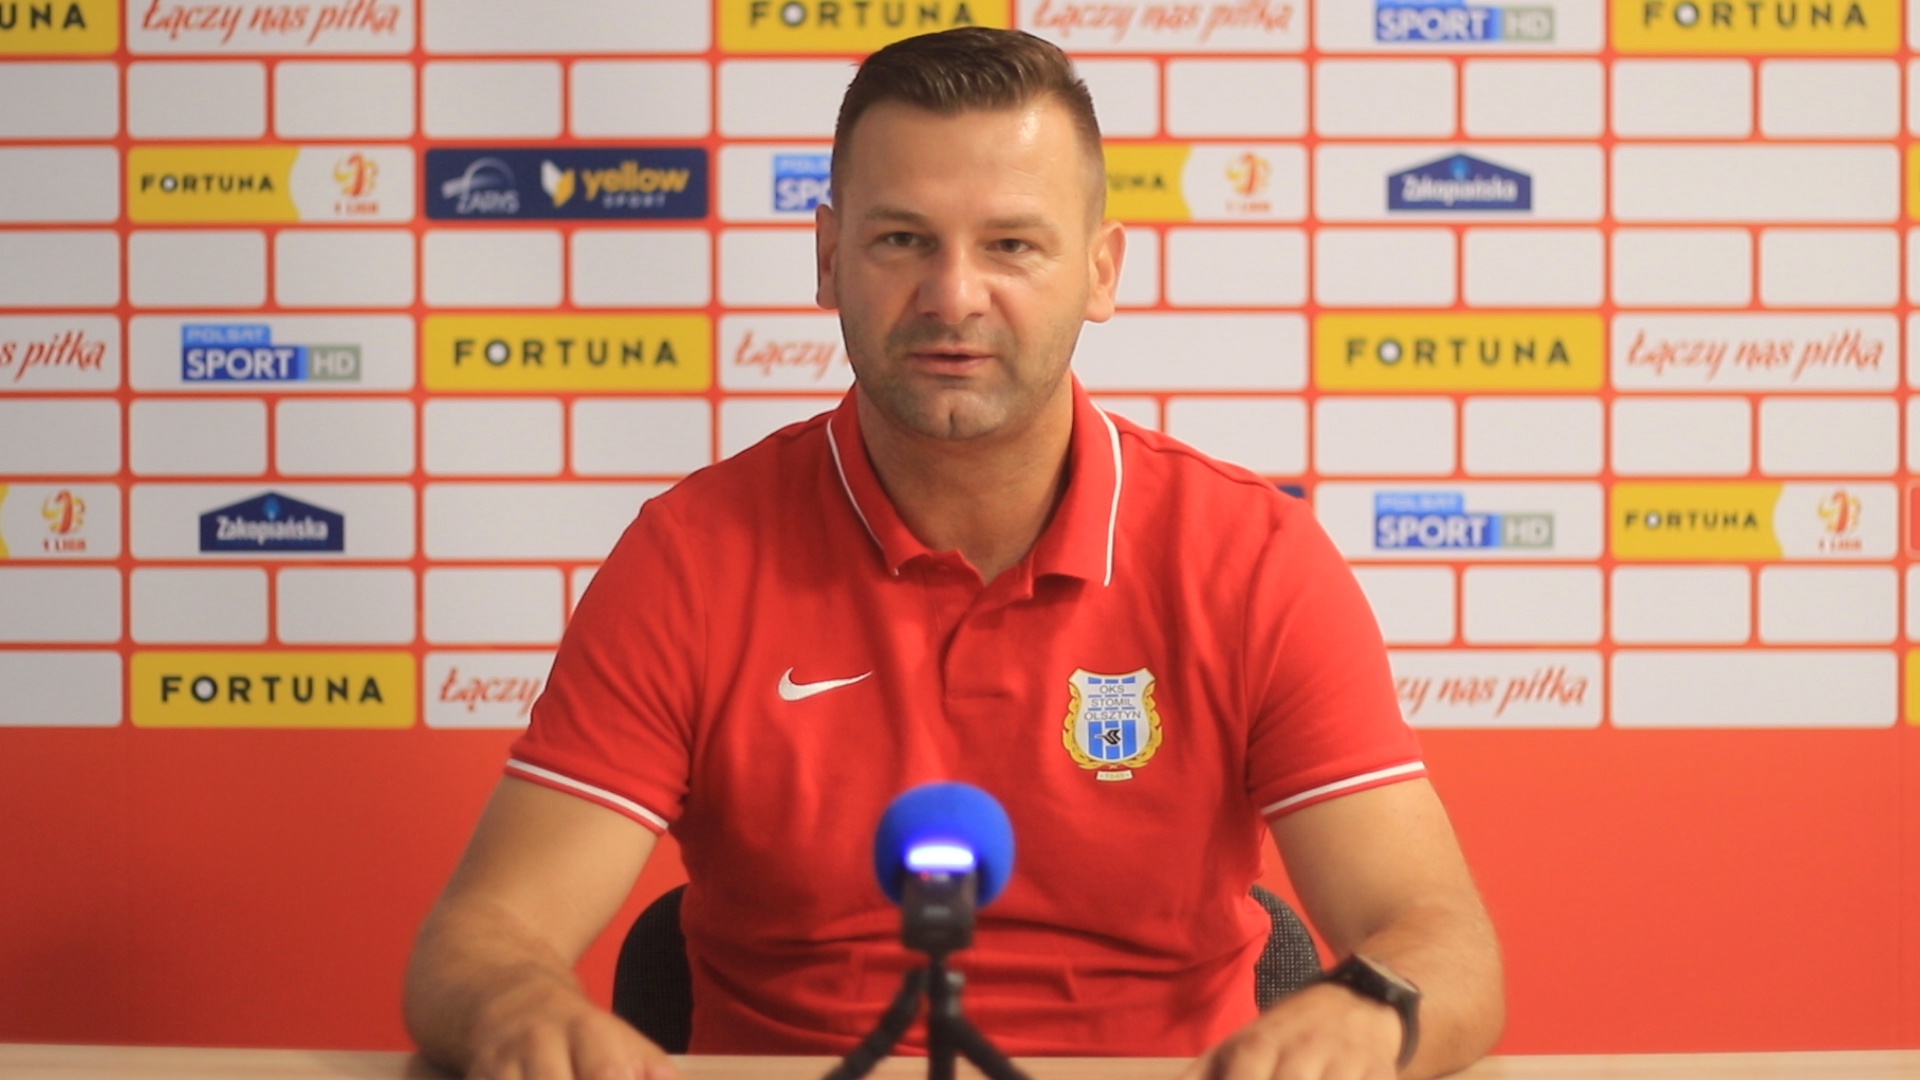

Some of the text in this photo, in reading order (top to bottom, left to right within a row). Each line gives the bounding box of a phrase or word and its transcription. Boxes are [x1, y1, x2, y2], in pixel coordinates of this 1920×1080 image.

[249, 5, 311, 34] nas
[750, 0, 976, 28] FORTUNA
[1378, 6, 1489, 41] SPORT
[1643, 0, 1868, 29] FORTUNA
[140, 174, 275, 194] FORTUNA
[582, 160, 690, 200] yellow
[13, 329, 106, 382] piłka
[186, 347, 356, 380] SPORT HD
[453, 339, 678, 367] FORTUNA
[1345, 337, 1570, 366] FORTUNA
[1735, 339, 1794, 370] nas
[216, 514, 329, 545] Zakopiańska
[1377, 514, 1489, 546] SPORT
[1624, 510, 1759, 530] FORTUNA
[161, 675, 384, 703] FORTUNA
[1090, 698, 1134, 708] STOMIL
[1099, 685, 1126, 695] OKS
[1438, 677, 1499, 706] nas
[1083, 711, 1142, 721] OLSZTYN
